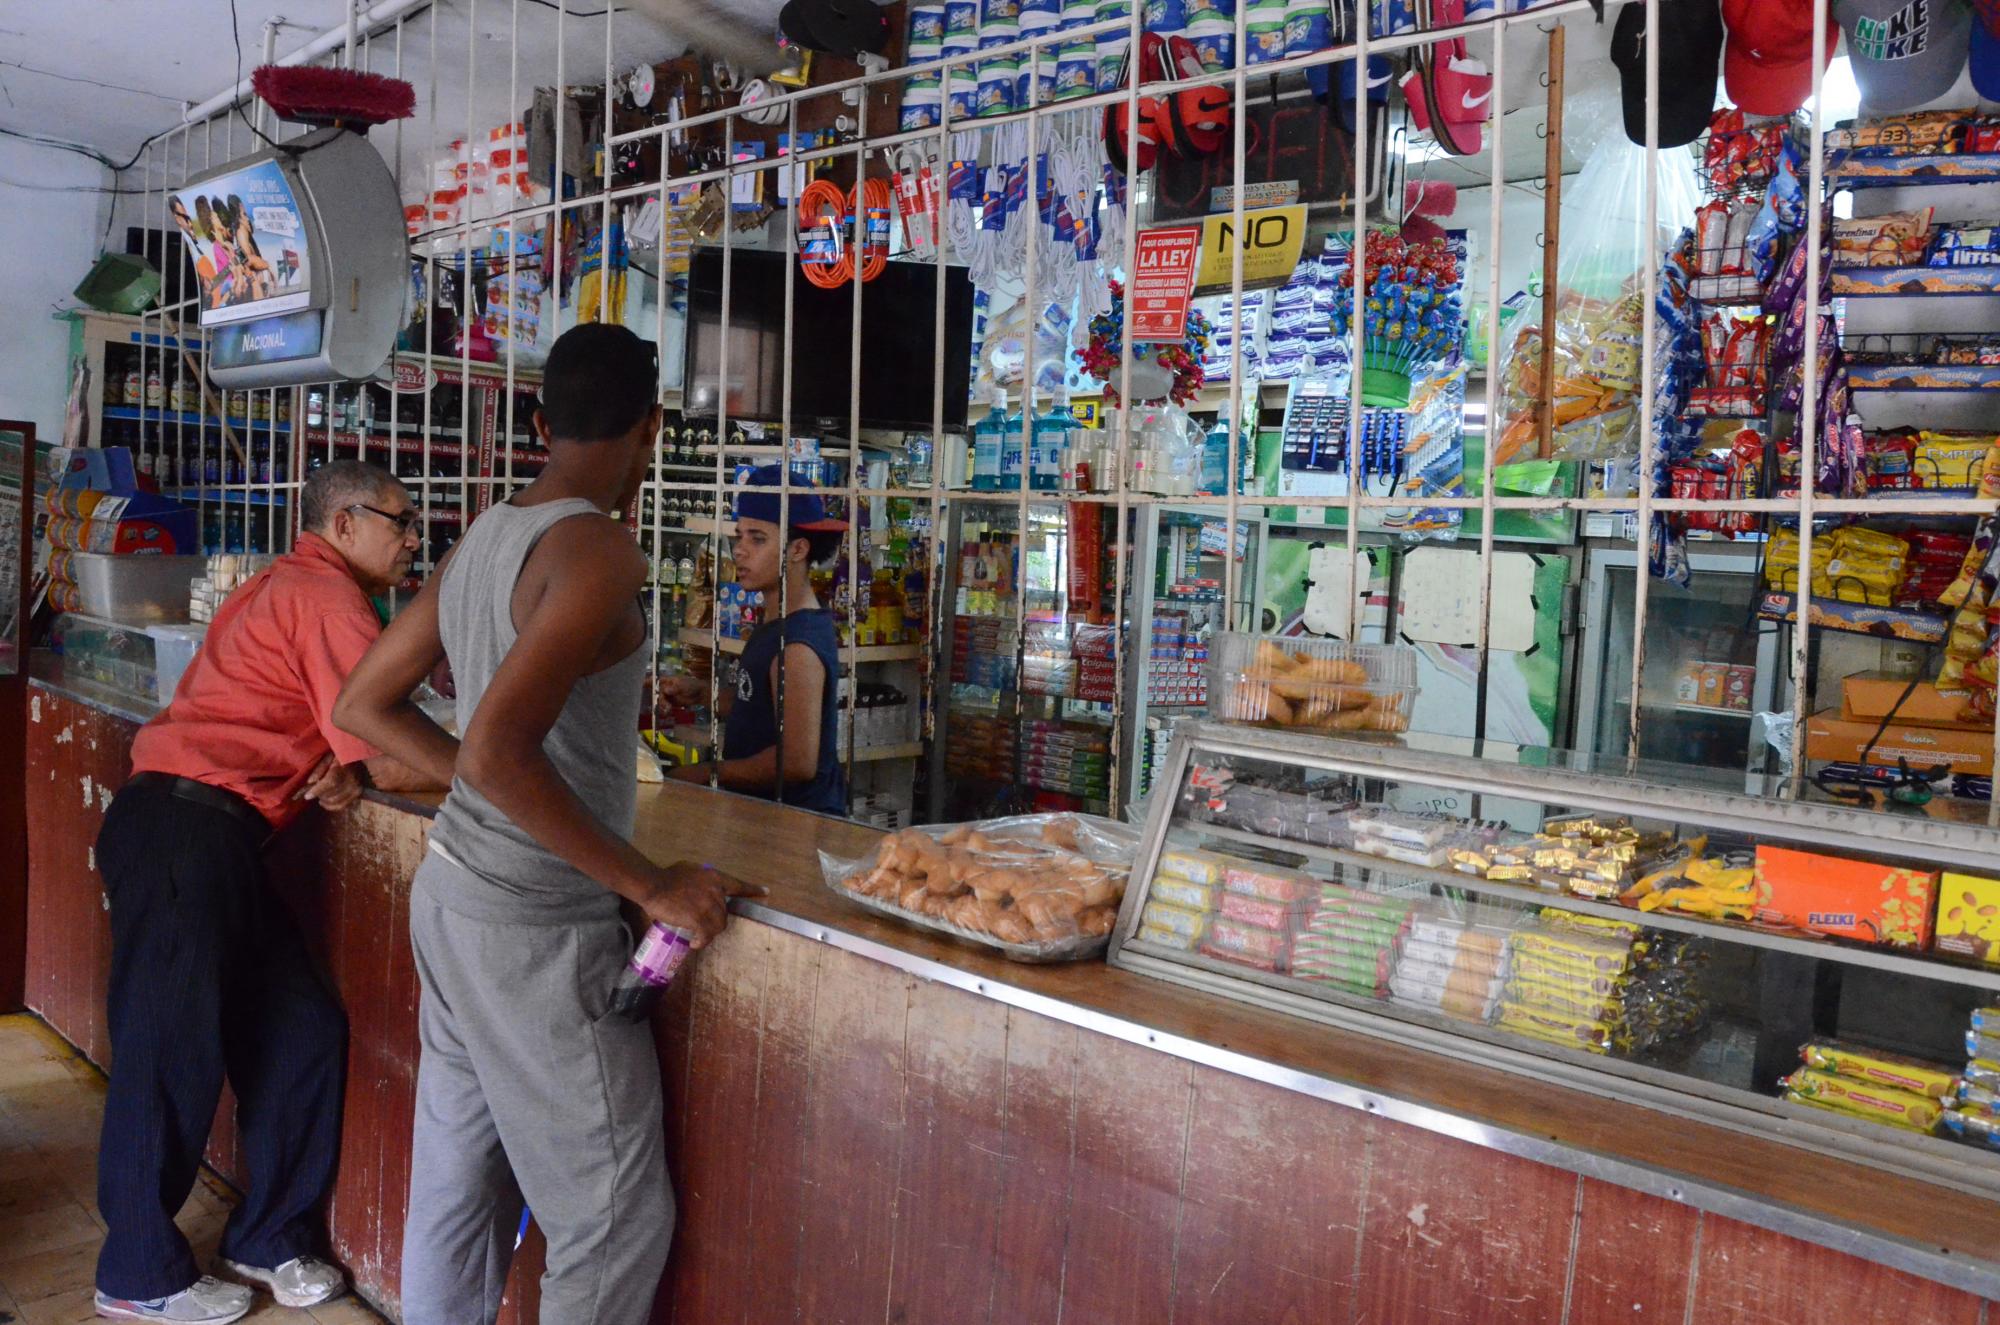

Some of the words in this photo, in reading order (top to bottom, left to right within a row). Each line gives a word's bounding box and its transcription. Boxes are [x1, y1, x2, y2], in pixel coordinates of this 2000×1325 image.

[1855, 0, 1929, 41] NIKE
[1855, 26, 1929, 60] NIKE
[1883, 130, 1904, 142] 33
[1219, 215, 1288, 253] NO
[1140, 251, 1158, 267] LA
[1161, 249, 1190, 267] LEY
[242, 328, 286, 352] NACIONAL
[308, 433, 326, 442] RON
[383, 440, 419, 450] BACELÓ
[1081, 656, 1117, 670] Colgate
[1080, 672, 1116, 685] Colgate
[1079, 686, 1116, 699] Colgate
[1808, 913, 1856, 926] FLEIKI
